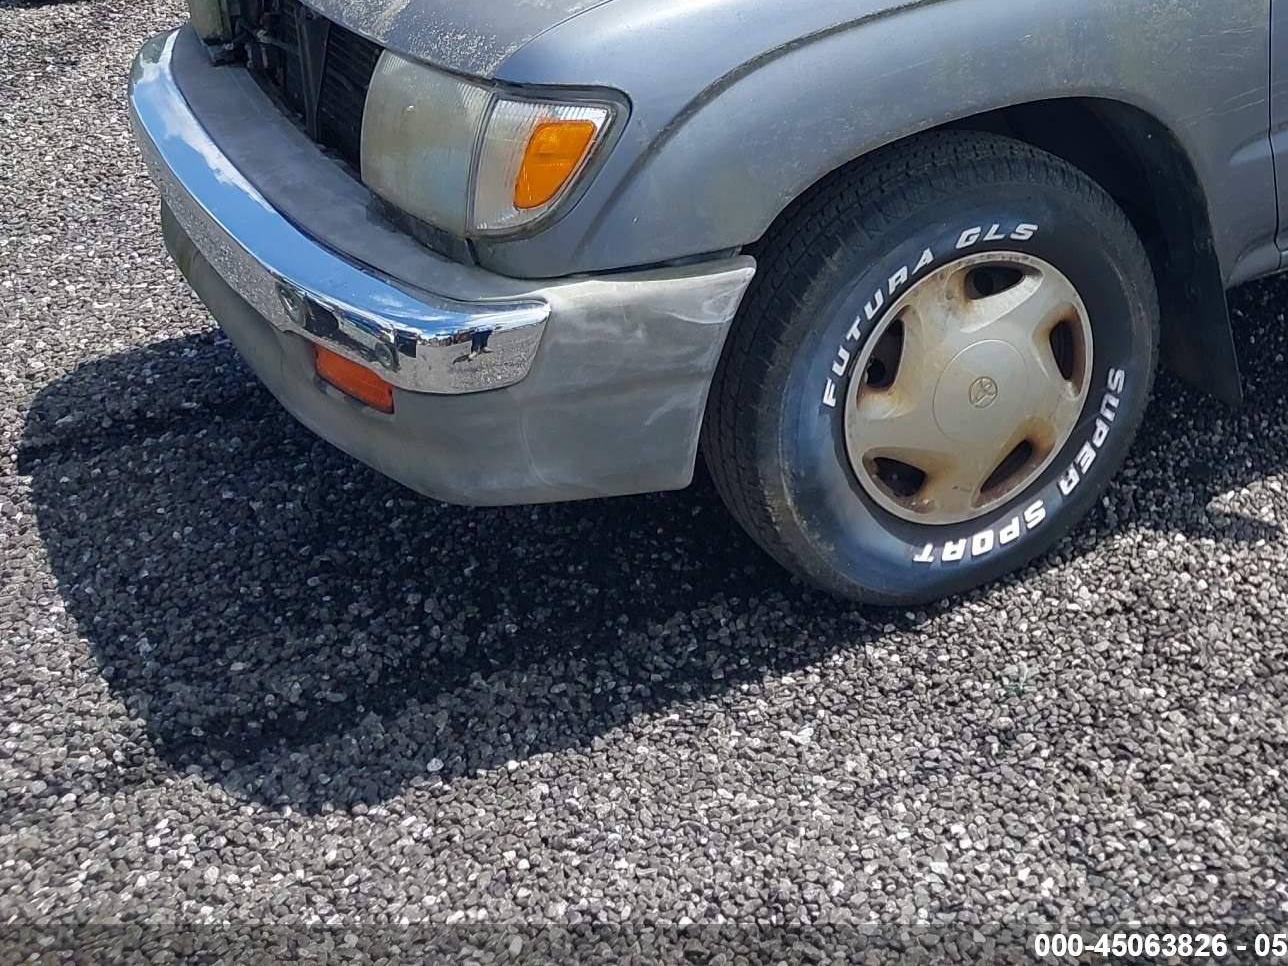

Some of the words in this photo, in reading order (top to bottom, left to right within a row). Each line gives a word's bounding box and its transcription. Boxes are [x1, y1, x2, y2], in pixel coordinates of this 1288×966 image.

[822, 247, 936, 408] FUTURA
[955, 223, 1040, 249] GLS
[1057, 367, 1126, 497] SUPER
[912, 499, 1047, 564] SPORT
